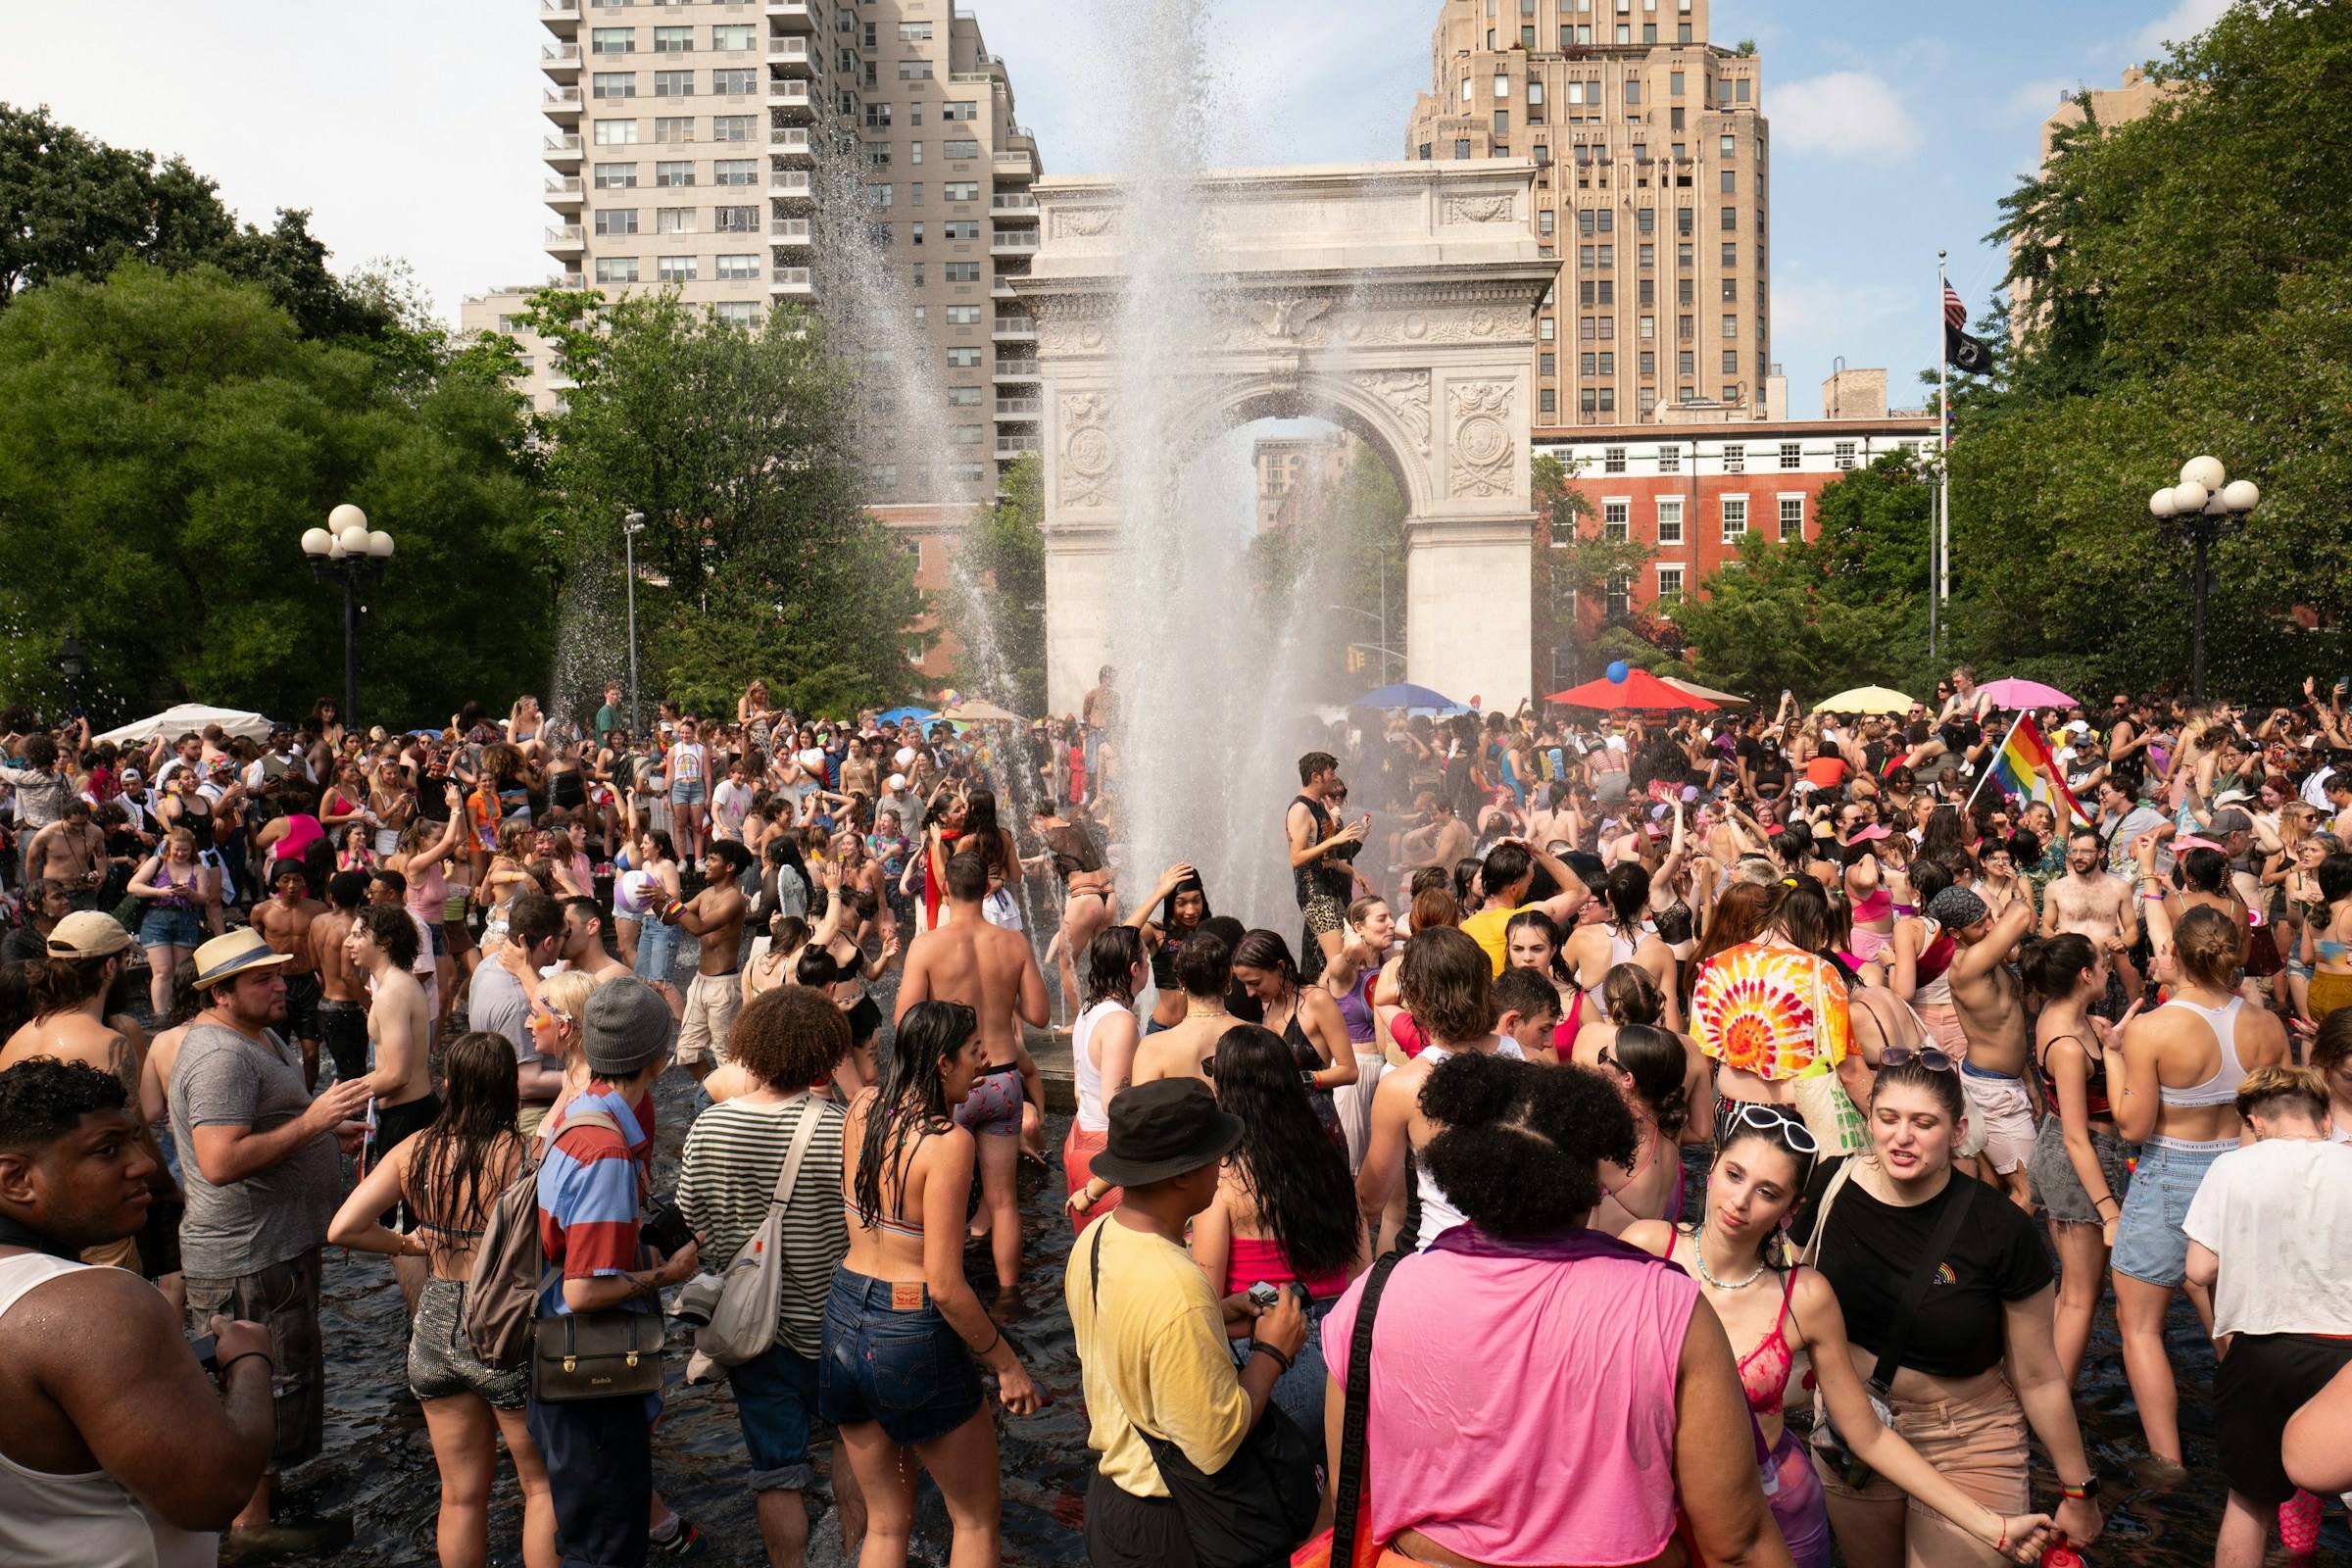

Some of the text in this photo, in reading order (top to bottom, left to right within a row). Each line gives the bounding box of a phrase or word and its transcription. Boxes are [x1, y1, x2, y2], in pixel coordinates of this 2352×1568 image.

[1349, 1323, 1372, 1394] BAGGU
[1344, 1400, 1365, 1467] BAGGU
[1337, 1474, 1358, 1539] BAGGU
